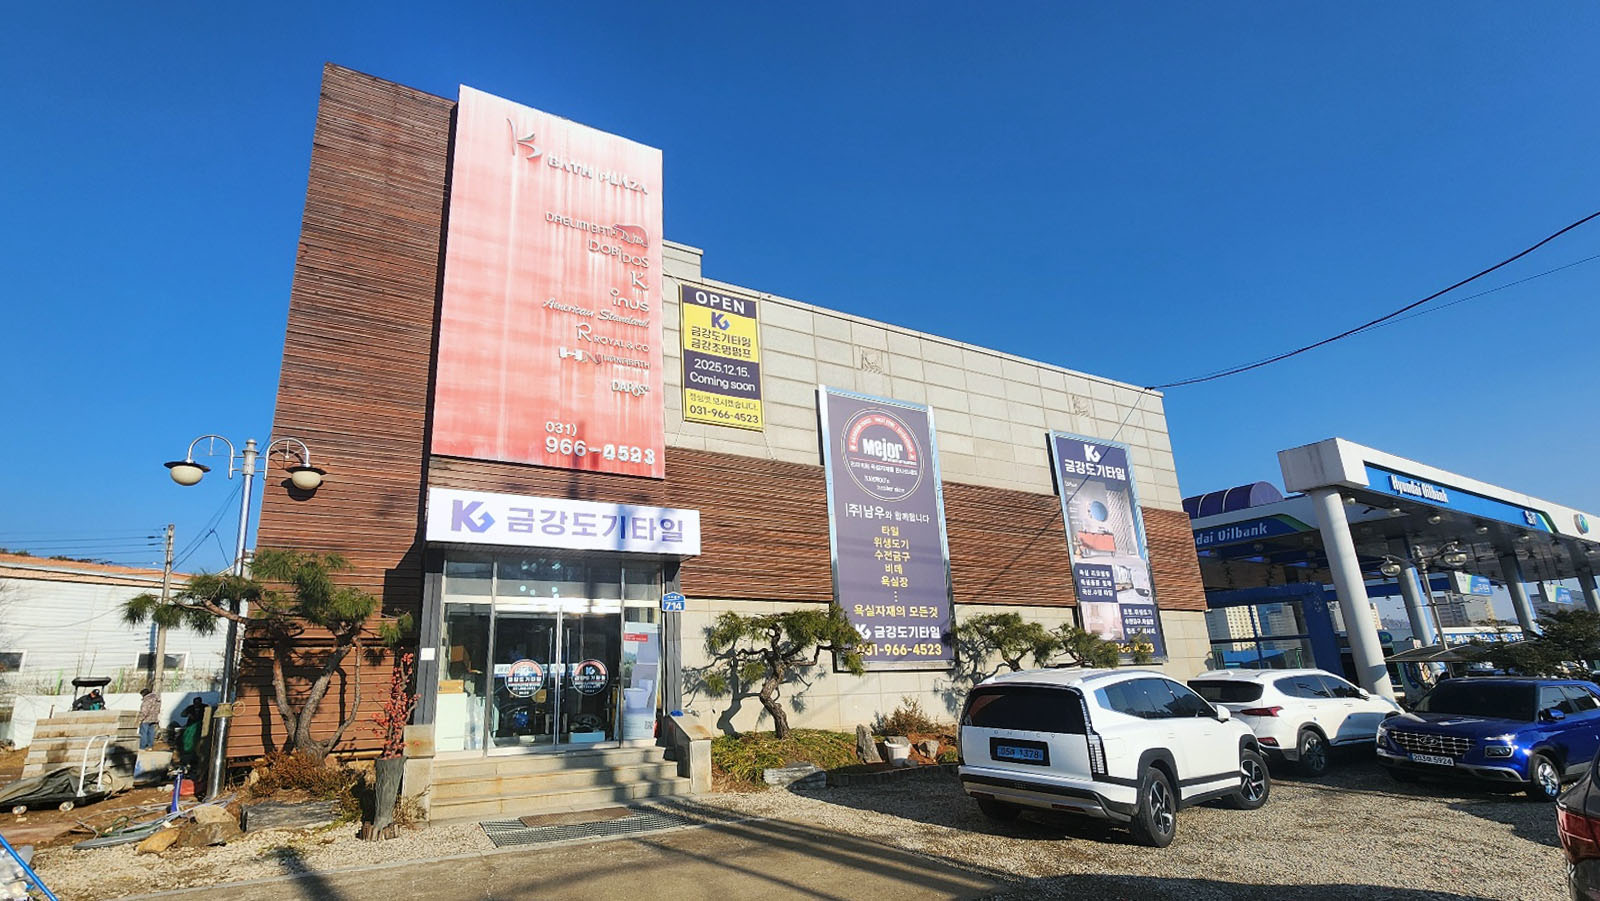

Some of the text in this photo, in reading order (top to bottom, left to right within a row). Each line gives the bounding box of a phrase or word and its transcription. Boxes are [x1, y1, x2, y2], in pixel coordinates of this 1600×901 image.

[548, 153, 648, 195] BATH PLAZA
[695, 291, 745, 315] OPEN
[542, 297, 650, 329] American Standard
[593, 335, 625, 349] ROYAL
[634, 344, 650, 353] CO
[691, 326, 752, 348] 금강도기타일
[694, 358, 751, 378] 2025.12.15.
[690, 371, 756, 392] Coming soon
[690, 405, 759, 424] 031-966-4523
[545, 421, 577, 437] 031)
[545, 436, 656, 465] 966-4523
[1065, 459, 1127, 481] 금강도기타일
[507, 507, 684, 543] 금강도기타일
[881, 526, 900, 537] 타일
[1218, 522, 1268, 541] Oilbank
[873, 537, 910, 550] 위생도기
[874, 550, 911, 562] 수전금구
[884, 563, 903, 575] 비데
[881, 576, 909, 588] 욕실장
[665, 601, 682, 611] 714
[853, 603, 939, 619] 욕실자재의 모든것
[874, 625, 941, 639] 금강도기타일
[856, 643, 943, 657] 031-966-4523
[1019, 749, 1039, 759] 1378
